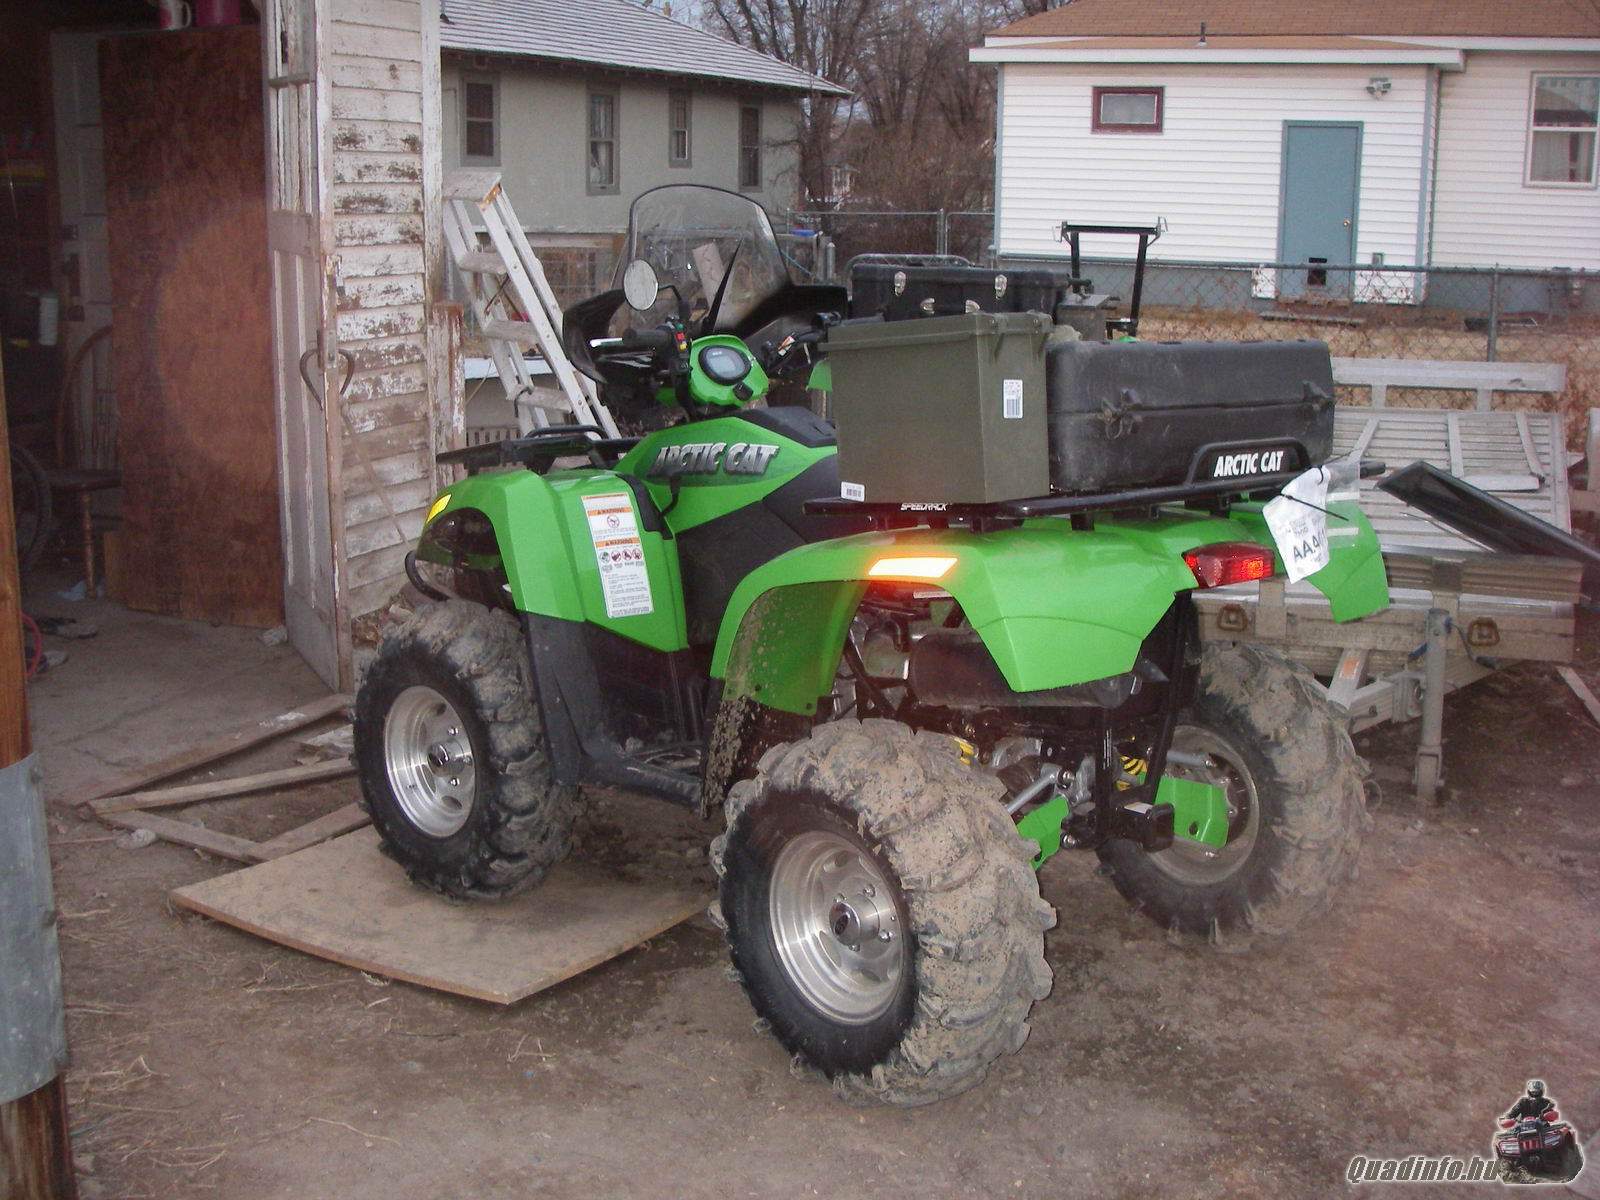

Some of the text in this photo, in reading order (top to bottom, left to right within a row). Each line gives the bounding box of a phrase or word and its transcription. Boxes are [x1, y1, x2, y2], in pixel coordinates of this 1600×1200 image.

[653, 442, 779, 474] ARCTIC CAT
[1213, 451, 1284, 477] ARCTIC CAT
[900, 502, 948, 511] SPEEDRACK
